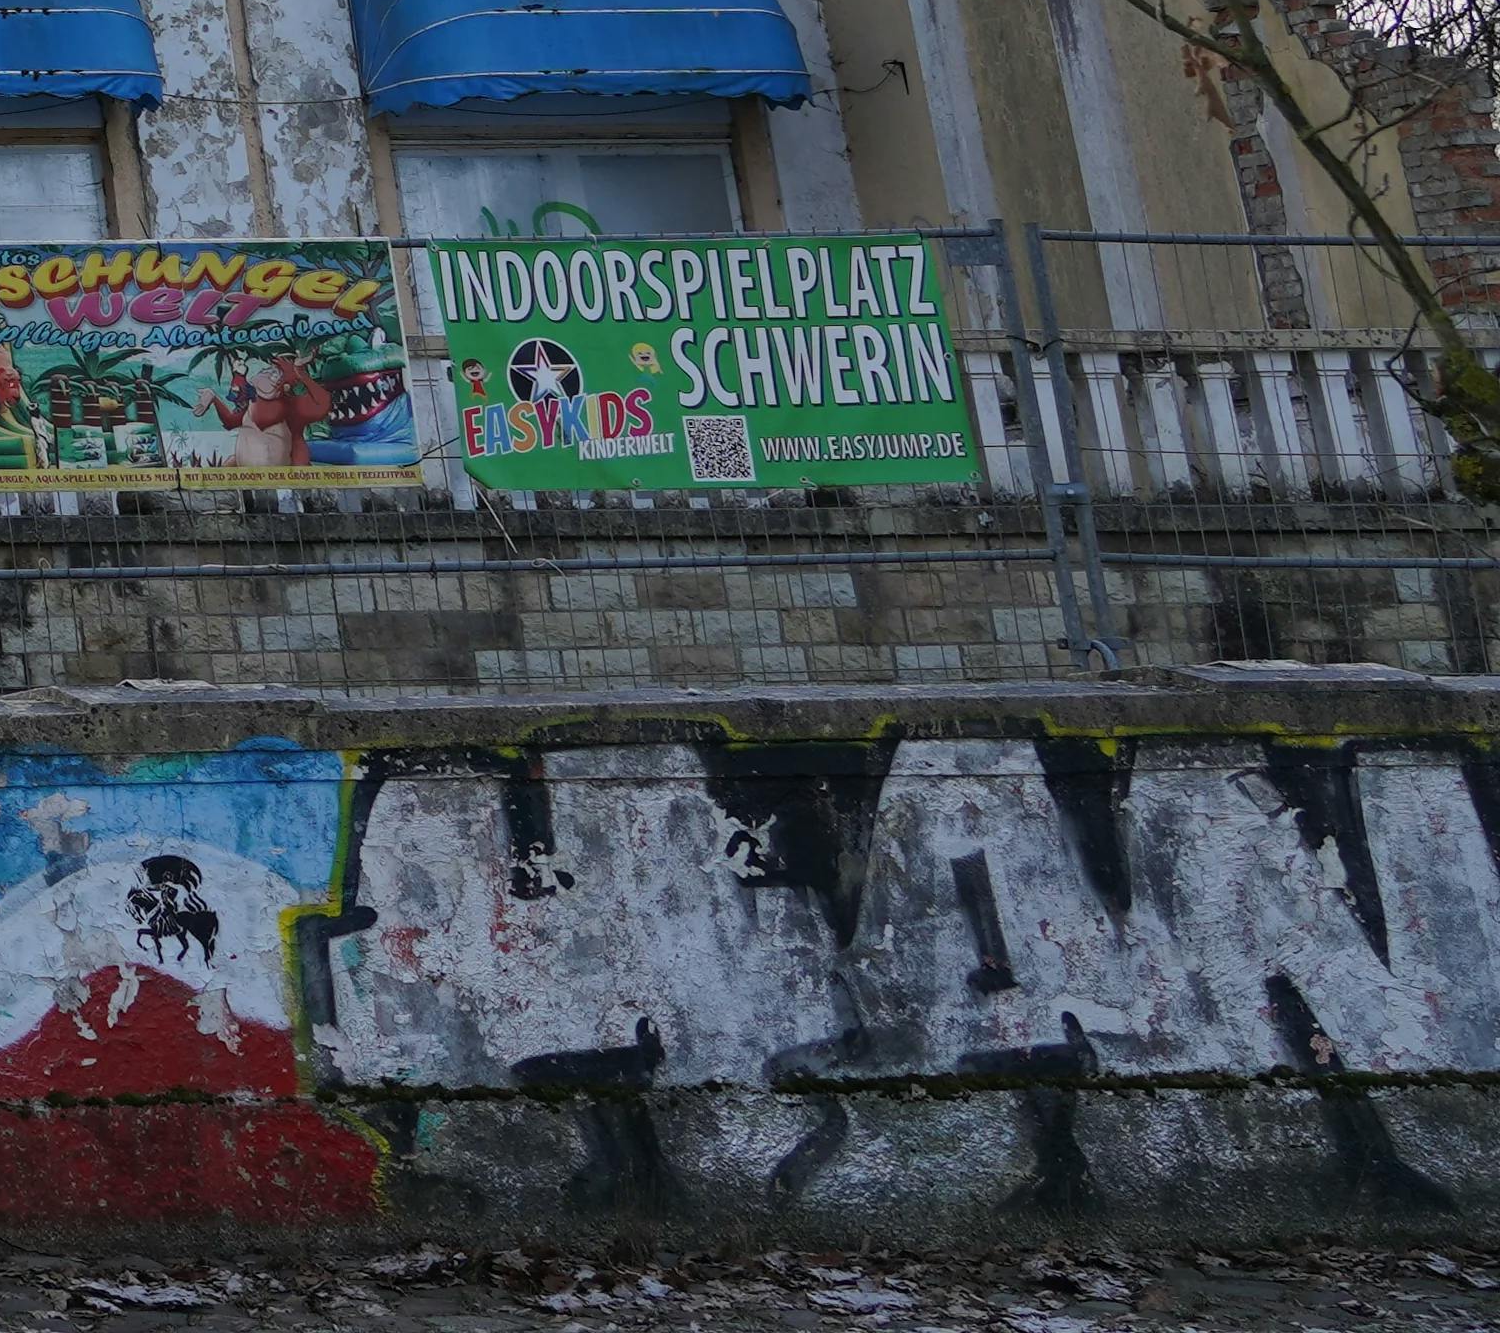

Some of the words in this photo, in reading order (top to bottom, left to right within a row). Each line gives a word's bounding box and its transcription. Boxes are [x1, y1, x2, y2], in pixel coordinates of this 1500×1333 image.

[438, 245, 936, 322] INDOORSPIELPLATZ
[670, 322, 956, 409] SCHWERIN
[461, 388, 655, 459] EASYKIDS
[578, 433, 675, 462] KINDERWELT
[760, 433, 966, 462] WWW.EASYJUMP.DE
[98, 473, 118, 483] UND
[120, 473, 153, 483] VIELES
